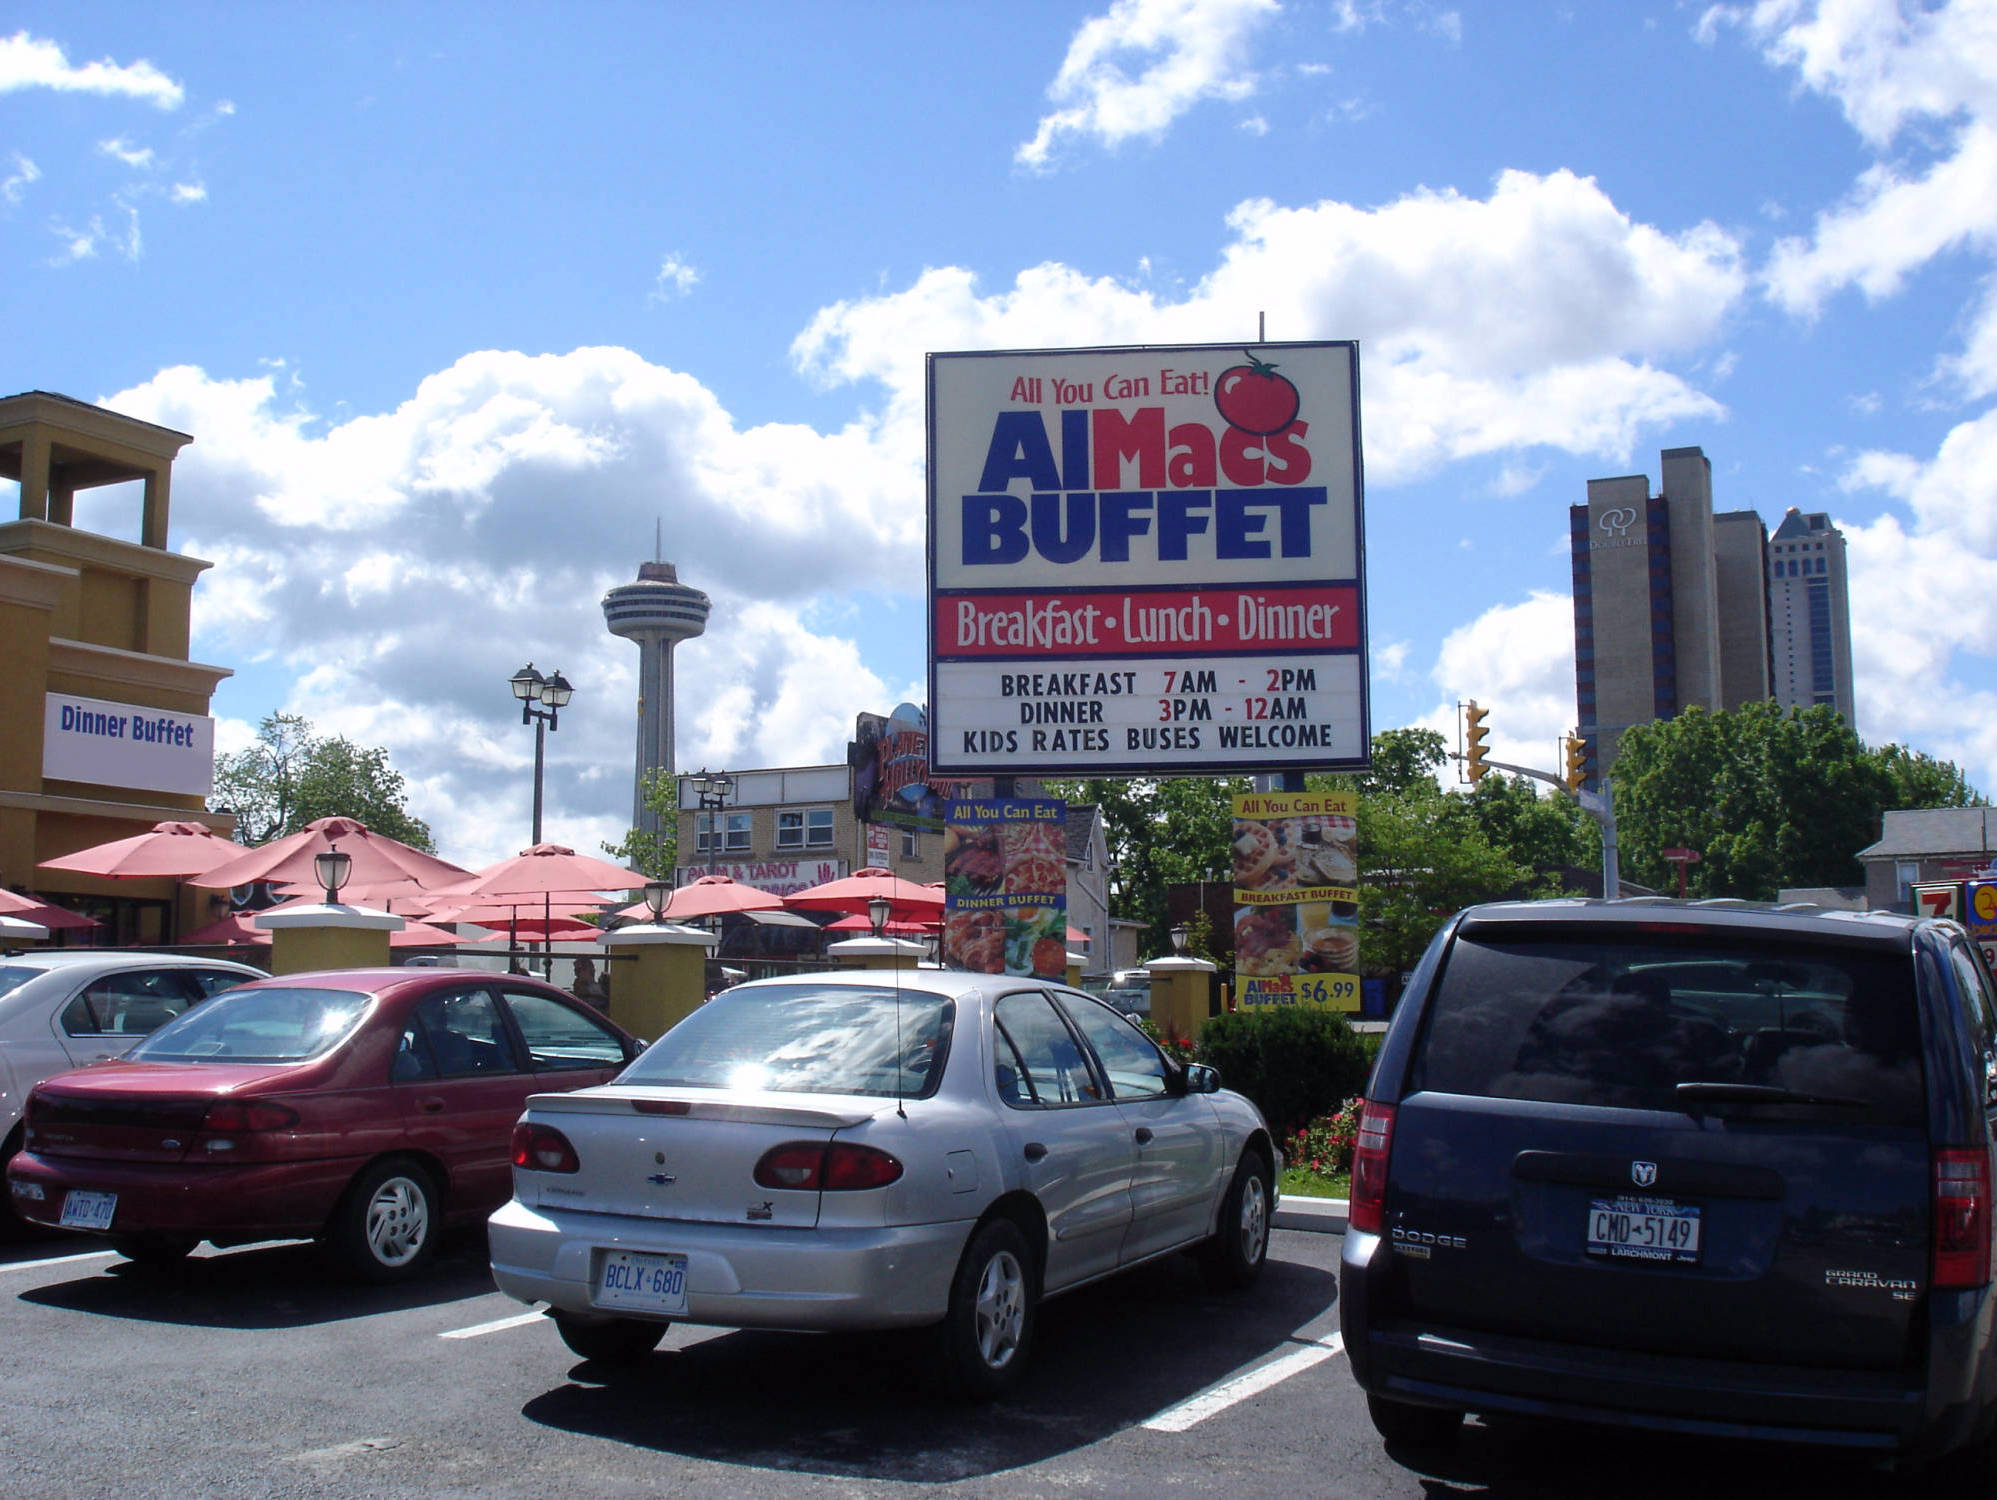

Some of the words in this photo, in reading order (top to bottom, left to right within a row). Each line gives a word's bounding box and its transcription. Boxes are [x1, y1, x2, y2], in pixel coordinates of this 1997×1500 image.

[1011, 376, 1042, 403] All
[1051, 378, 1093, 404] You
[1104, 373, 1149, 400] Can
[1160, 368, 1210, 396] Eat!
[961, 486, 1328, 566] BUFFET
[957, 600, 1101, 649] Breakfast
[1123, 597, 1212, 644] Lunch
[1238, 595, 1340, 641] Dinner
[1001, 671, 1137, 697] BREAKFAST
[1164, 670, 1217, 694] 7AM
[1266, 668, 1317, 692] 2PM
[1020, 701, 1104, 724] DINNER
[1159, 699, 1212, 722] 3PM
[1245, 697, 1308, 720] 12AM
[61, 704, 127, 738] Dinner
[132, 715, 194, 747] Buffet
[963, 729, 1018, 753] KIDS
[1033, 727, 1110, 752] RATES
[1127, 726, 1201, 750] BUSES
[1219, 724, 1332, 749] WELCOME
[953, 806, 971, 819] All
[975, 805, 998, 819] You
[1004, 804, 1030, 818] Can
[1034, 804, 1057, 818] Eat
[1242, 800, 1259, 814] All
[1263, 800, 1288, 813] You
[1293, 799, 1320, 813] Can
[1324, 799, 1346, 812] Eat
[687, 866, 728, 882] PAM
[732, 864, 744, 880] &
[745, 862, 798, 880] TAROT
[957, 898, 1004, 908] DINNER
[1008, 895, 1055, 905] BUFFET
[1241, 890, 1306, 904] BREAKFAST
[1311, 890, 1353, 900] BUFFET
[1244, 991, 1297, 1006] BUFFET
[1301, 979, 1355, 1003] $6.99
[1392, 1228, 1468, 1249] DODGE
